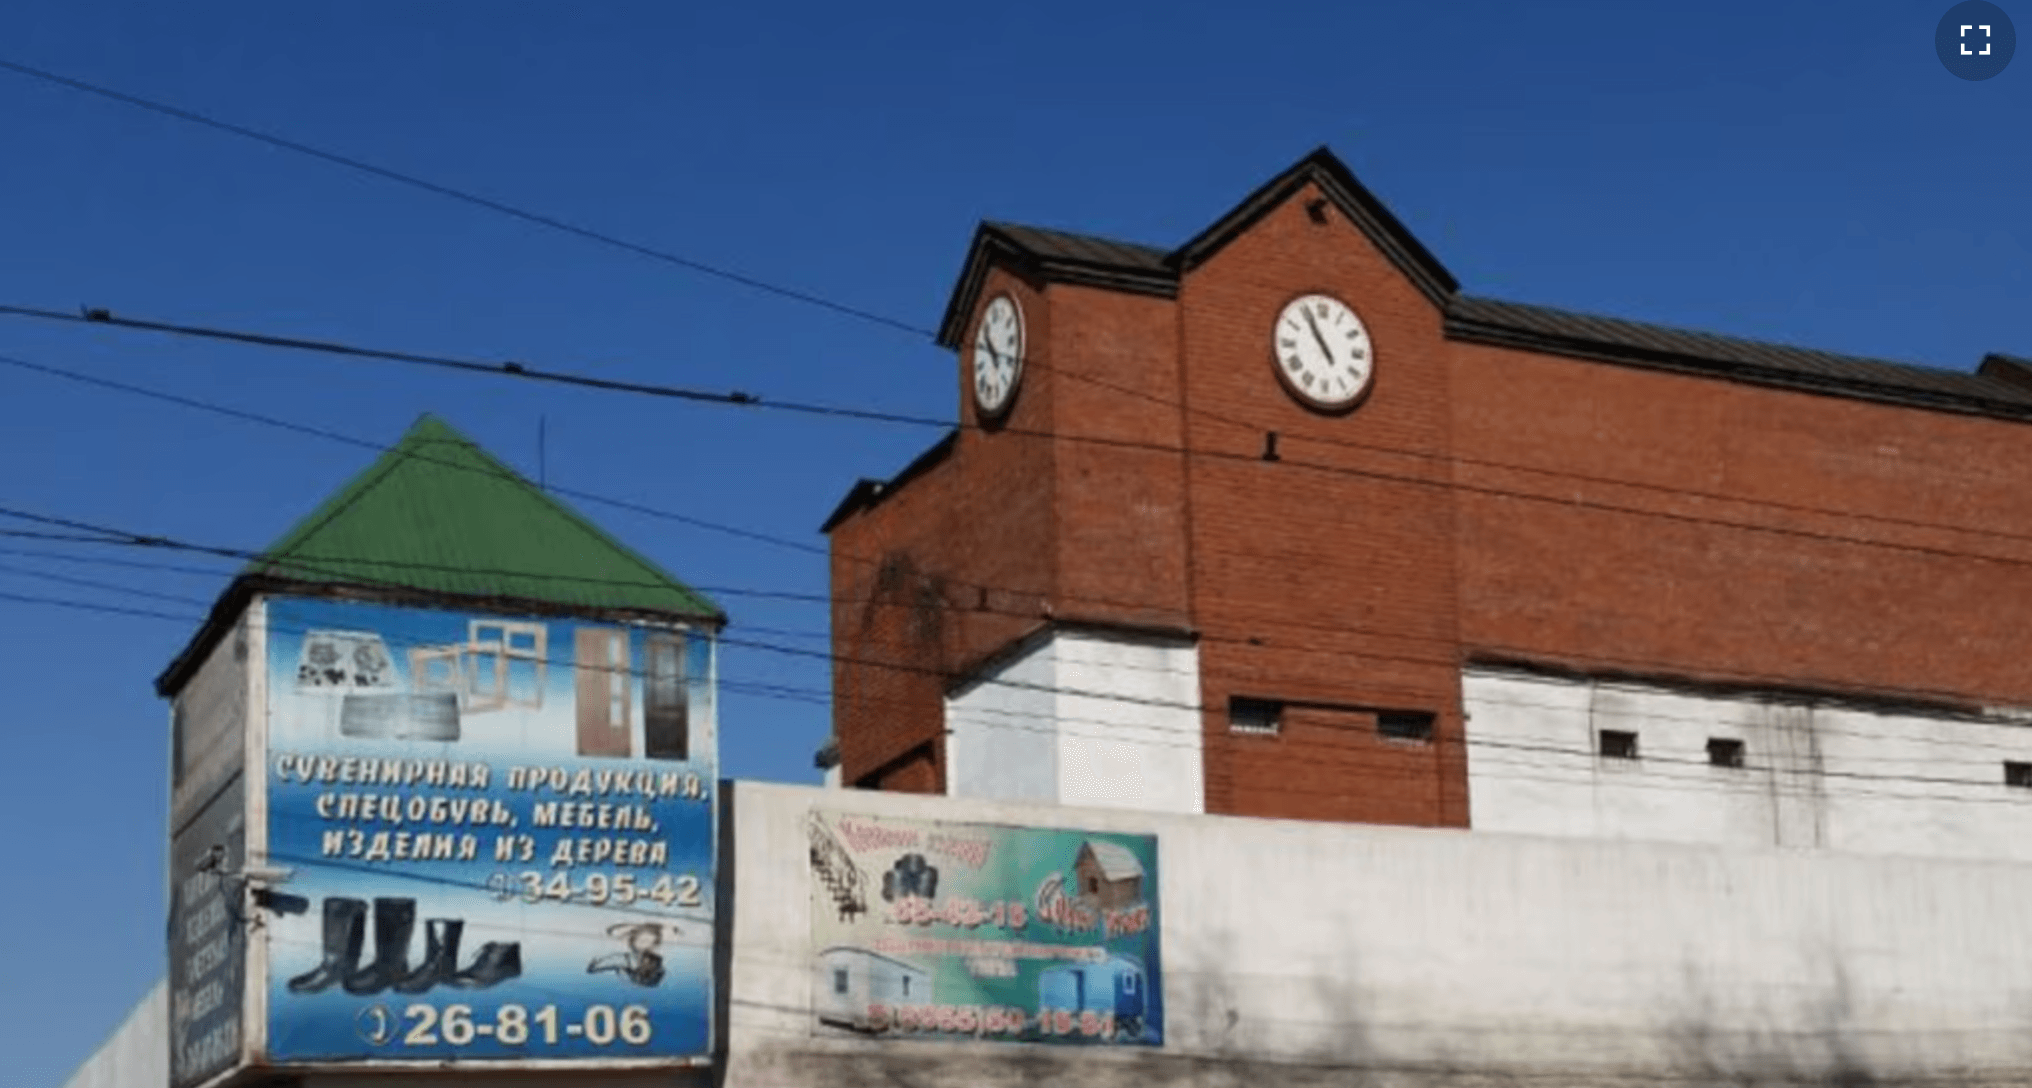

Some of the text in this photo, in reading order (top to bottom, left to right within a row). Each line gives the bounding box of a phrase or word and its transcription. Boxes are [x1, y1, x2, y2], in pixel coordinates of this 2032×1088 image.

[276, 755, 709, 801] СУВЕНИРНАЯ ПРОДУКЦИЯ,
[316, 793, 660, 833] СПЕЦОБУВЬ, МЕБЕЛЬ,
[321, 830, 668, 866] ИЗДЕЛИЯ ИЗ ДЕРЕВА
[520, 871, 701, 907] 34-95-42
[404, 1004, 652, 1046] 26-81-06
